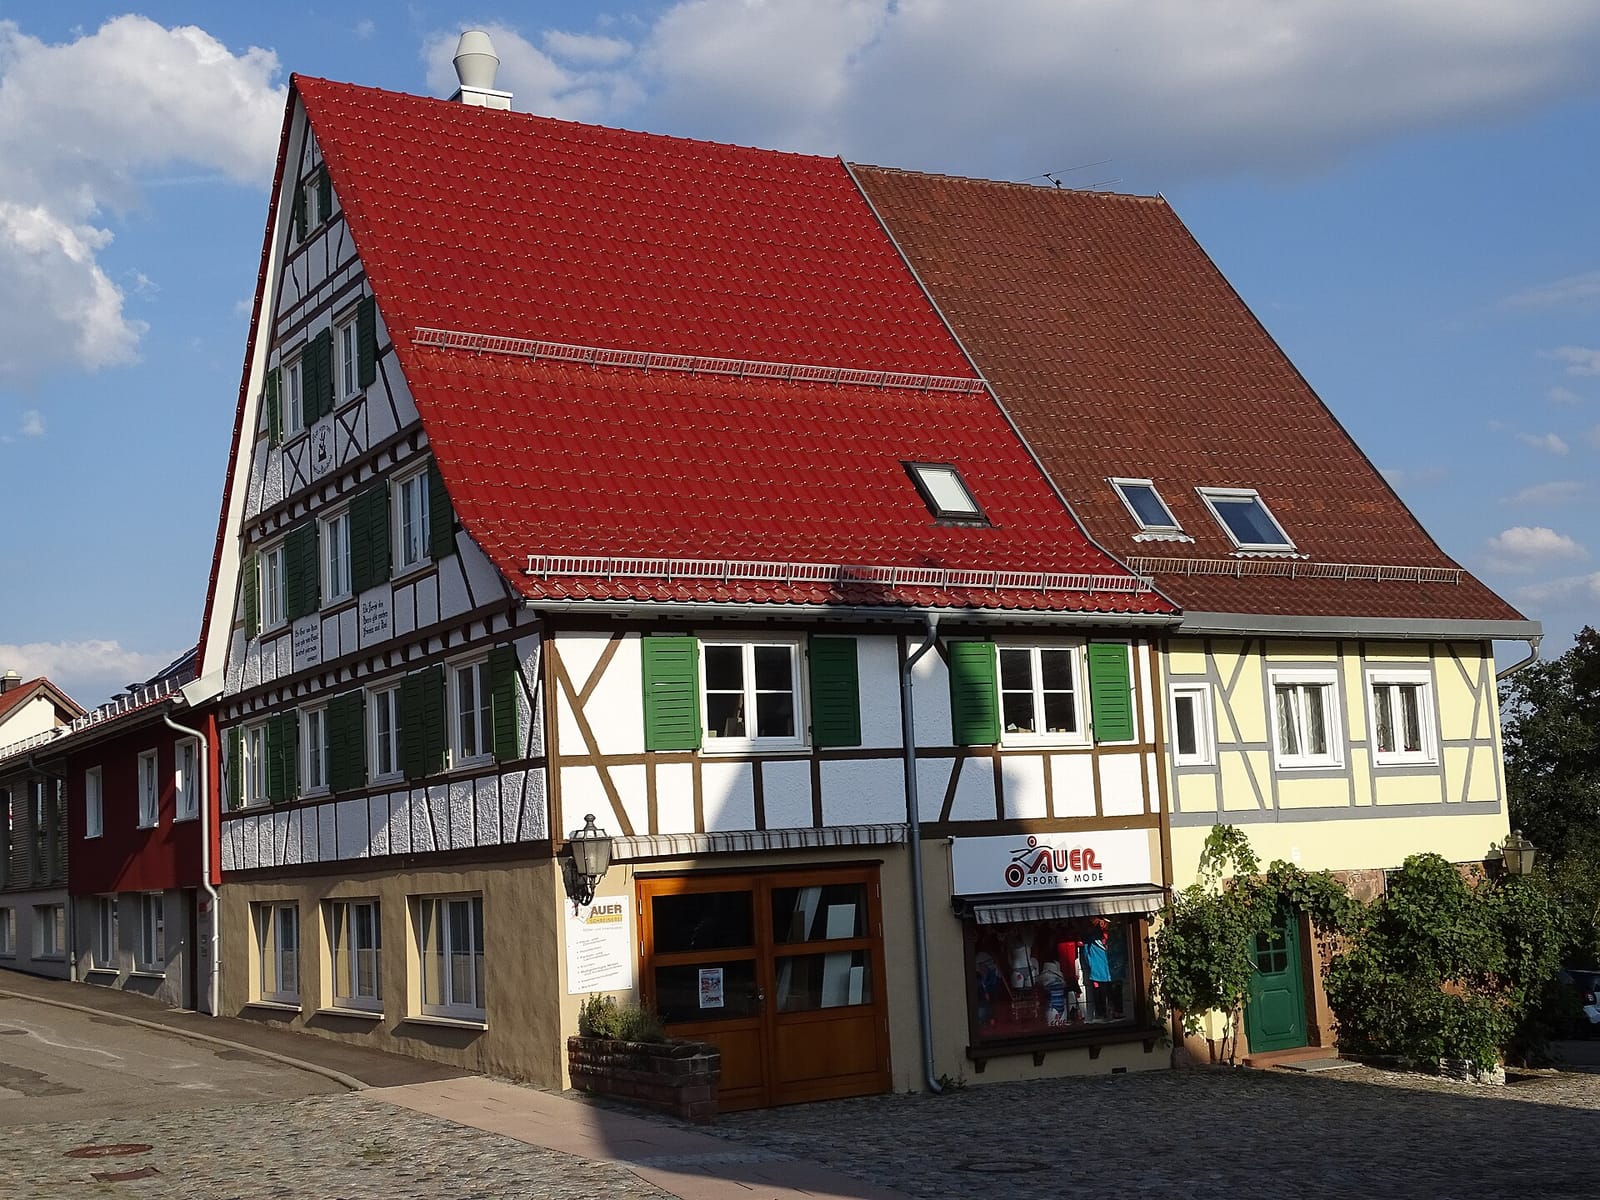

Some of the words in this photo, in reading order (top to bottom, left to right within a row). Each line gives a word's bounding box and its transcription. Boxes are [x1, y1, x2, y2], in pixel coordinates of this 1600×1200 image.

[1027, 848, 1102, 874] AUER
[1027, 876, 1059, 886] SPORT
[1074, 873, 1103, 882] MODE
[590, 904, 622, 917] AUER
